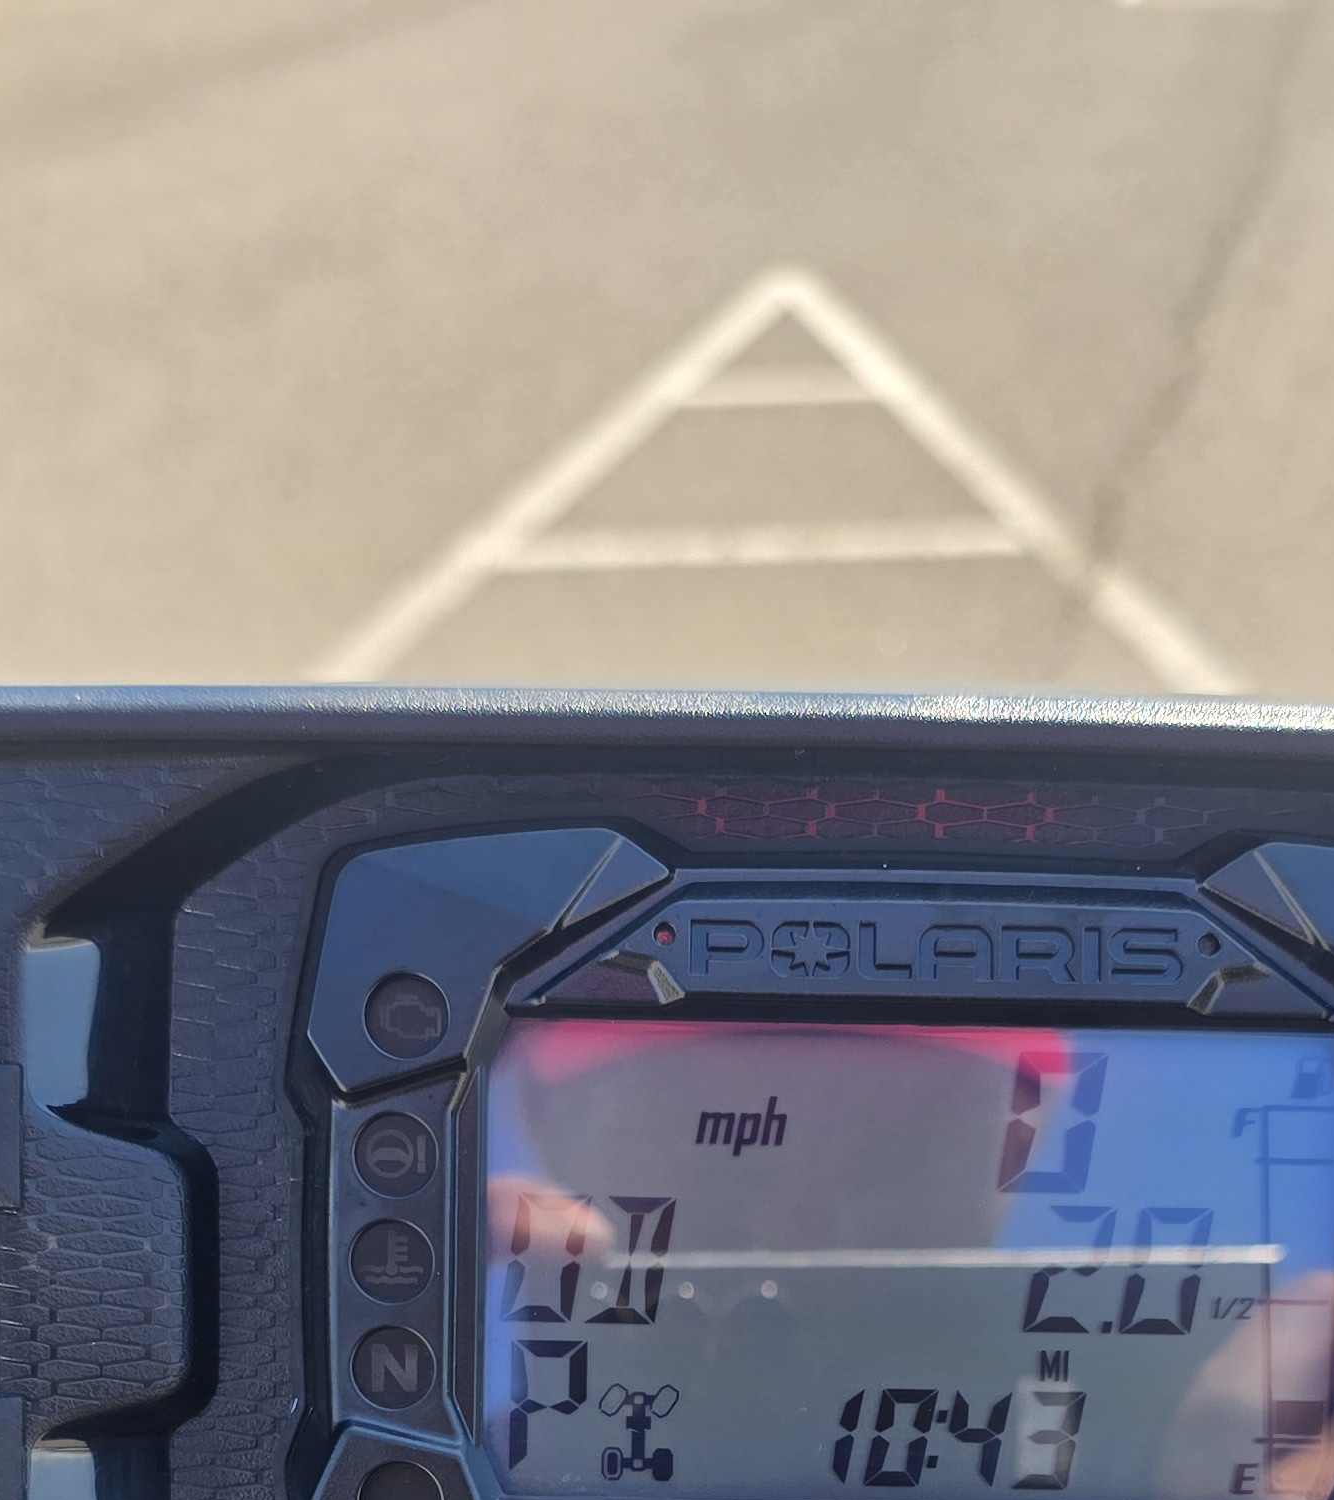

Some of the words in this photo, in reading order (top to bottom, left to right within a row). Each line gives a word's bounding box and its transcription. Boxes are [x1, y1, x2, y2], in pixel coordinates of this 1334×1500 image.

[689, 919, 1184, 986] POLARIS
[695, 1096, 787, 1157] mph
[1022, 1205, 1214, 1335] 2.0
[1210, 1296, 1255, 1321] 1/2
[370, 1343, 418, 1393] N
[1039, 1350, 1070, 1382] MI
[509, 1340, 588, 1471] P
[832, 1388, 1087, 1490] 10:43
[1228, 1463, 1259, 1494] E
